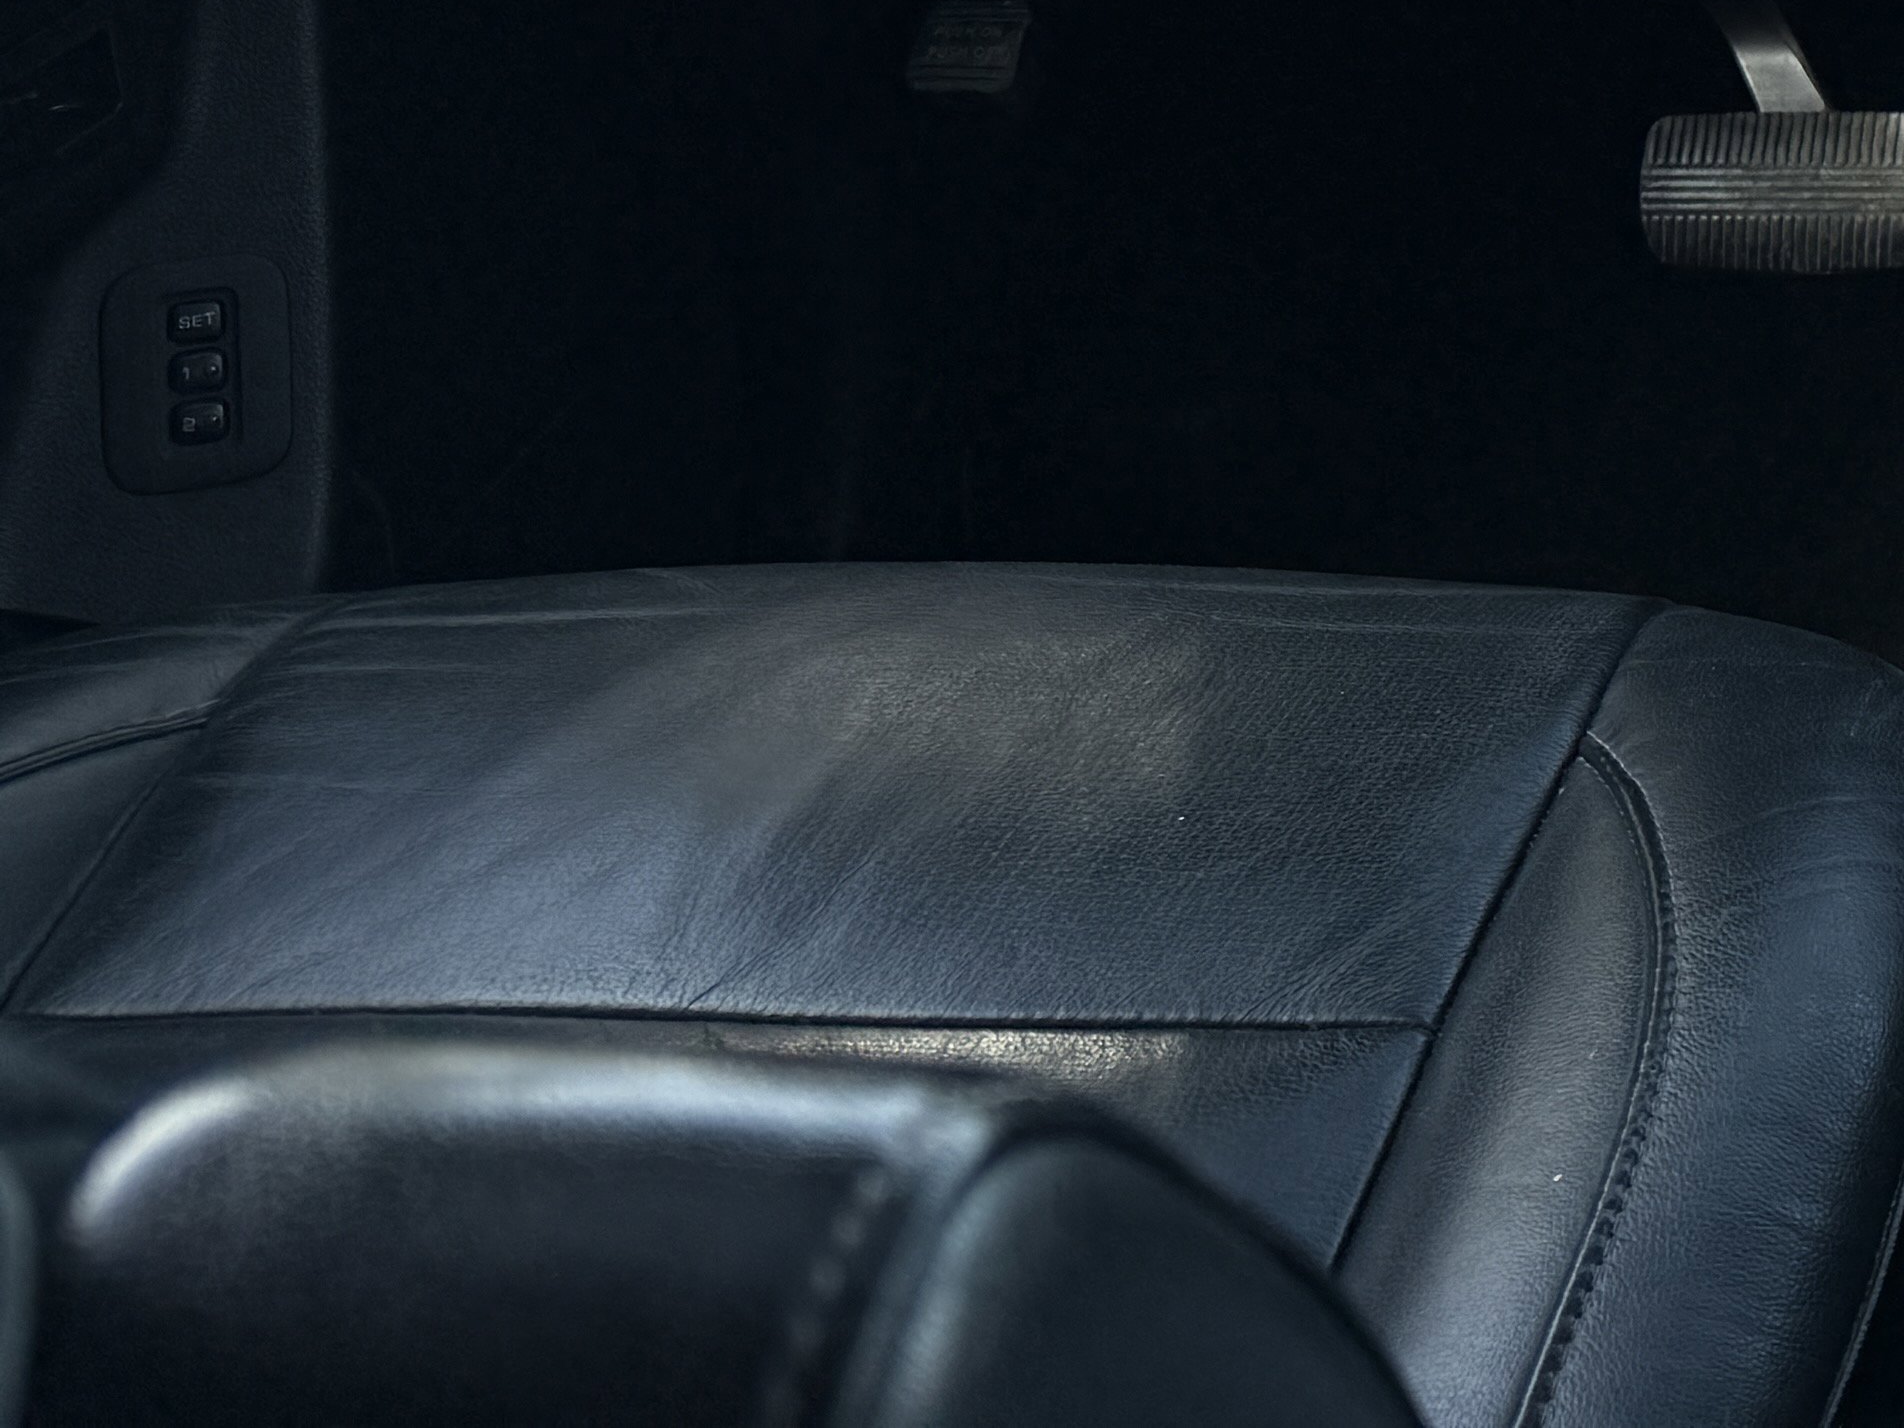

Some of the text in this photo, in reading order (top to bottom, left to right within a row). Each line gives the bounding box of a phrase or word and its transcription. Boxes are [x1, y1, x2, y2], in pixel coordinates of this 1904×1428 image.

[178, 311, 216, 329] SET
[182, 366, 190, 380] 1
[181, 416, 197, 433] 2
